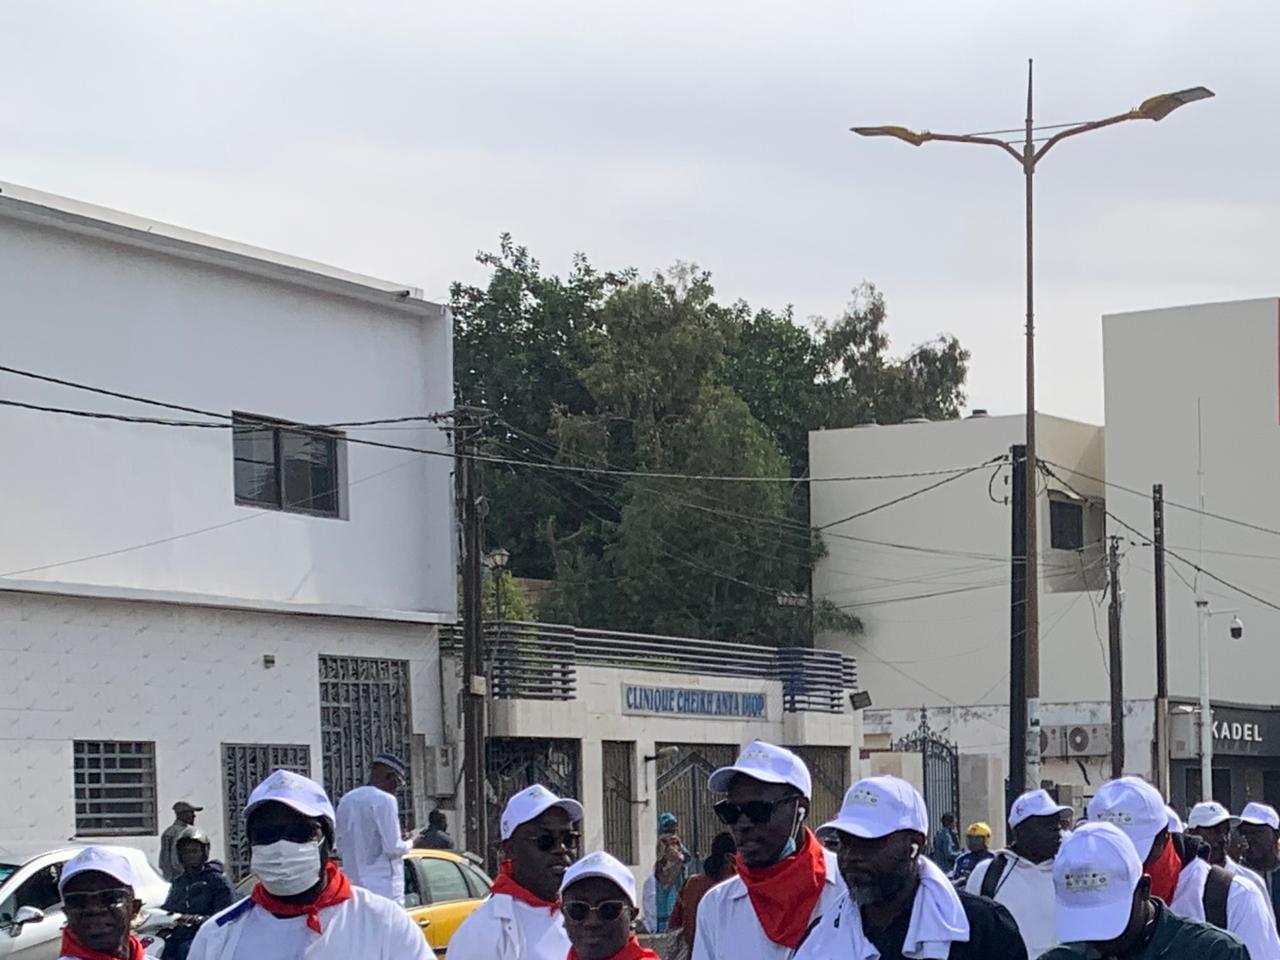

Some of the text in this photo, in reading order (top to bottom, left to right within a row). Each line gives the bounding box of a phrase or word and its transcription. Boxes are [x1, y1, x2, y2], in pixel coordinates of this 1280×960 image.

[626, 686, 675, 713] CLINIQUE
[677, 688, 713, 714] CHEIKH
[715, 691, 739, 716] ANTA
[1211, 720, 1263, 742] KADEL
